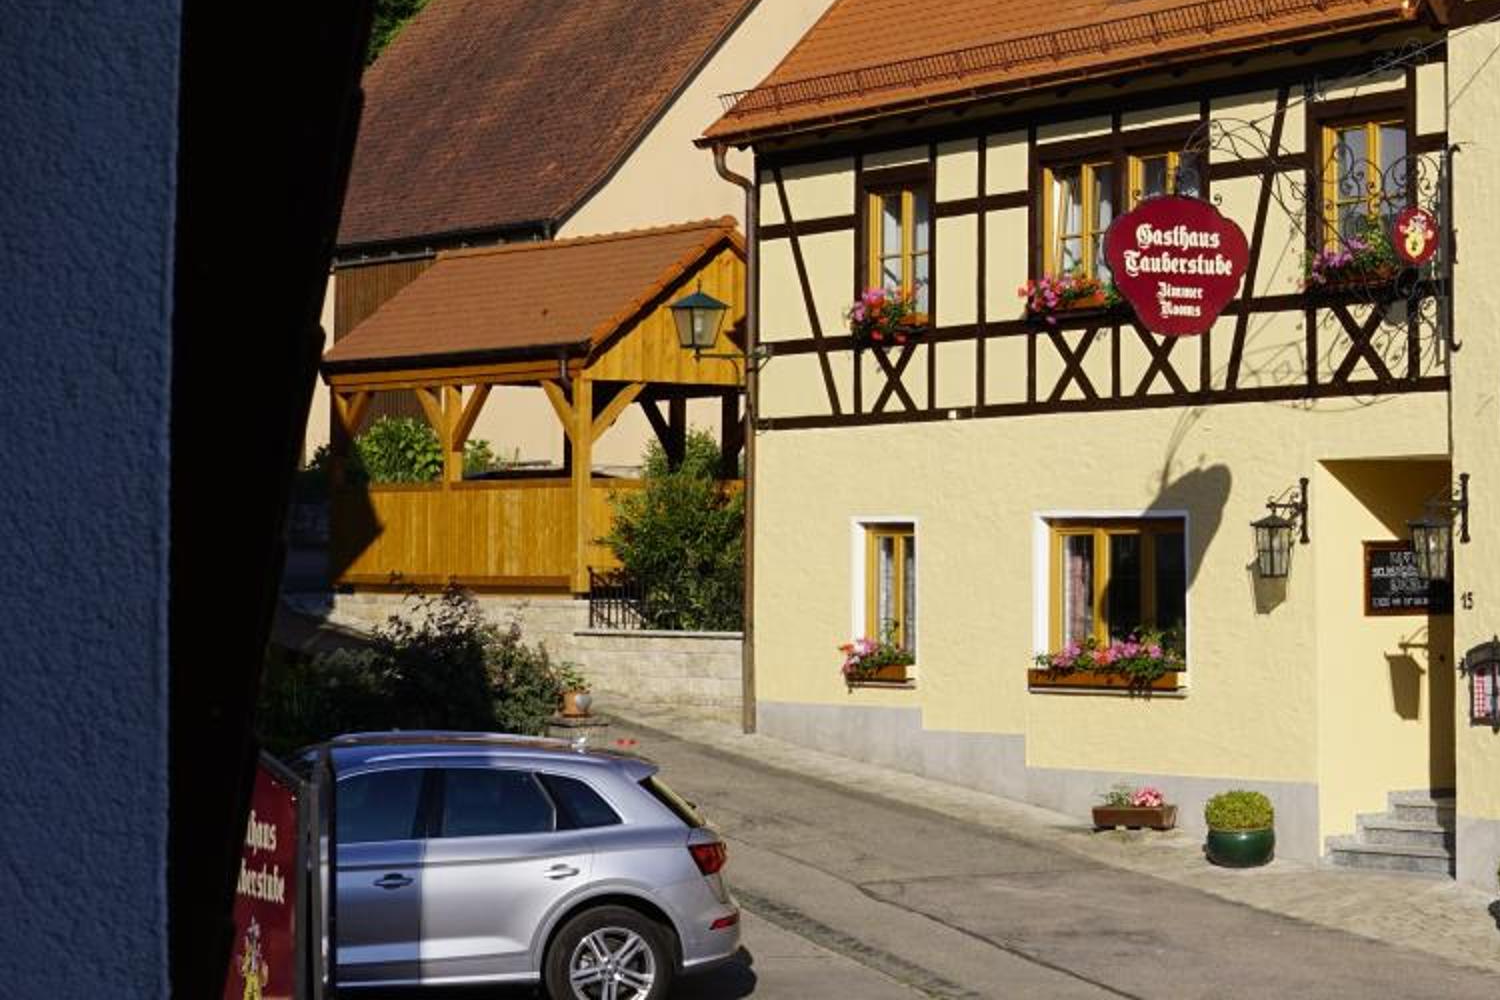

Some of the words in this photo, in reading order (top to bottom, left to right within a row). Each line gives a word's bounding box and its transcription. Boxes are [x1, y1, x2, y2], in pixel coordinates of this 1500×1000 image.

[1136, 223, 1220, 251] Gasthaus
[1123, 250, 1233, 277] Tauberstube
[1156, 281, 1204, 299] Zimmer
[1159, 300, 1202, 319] Rooms
